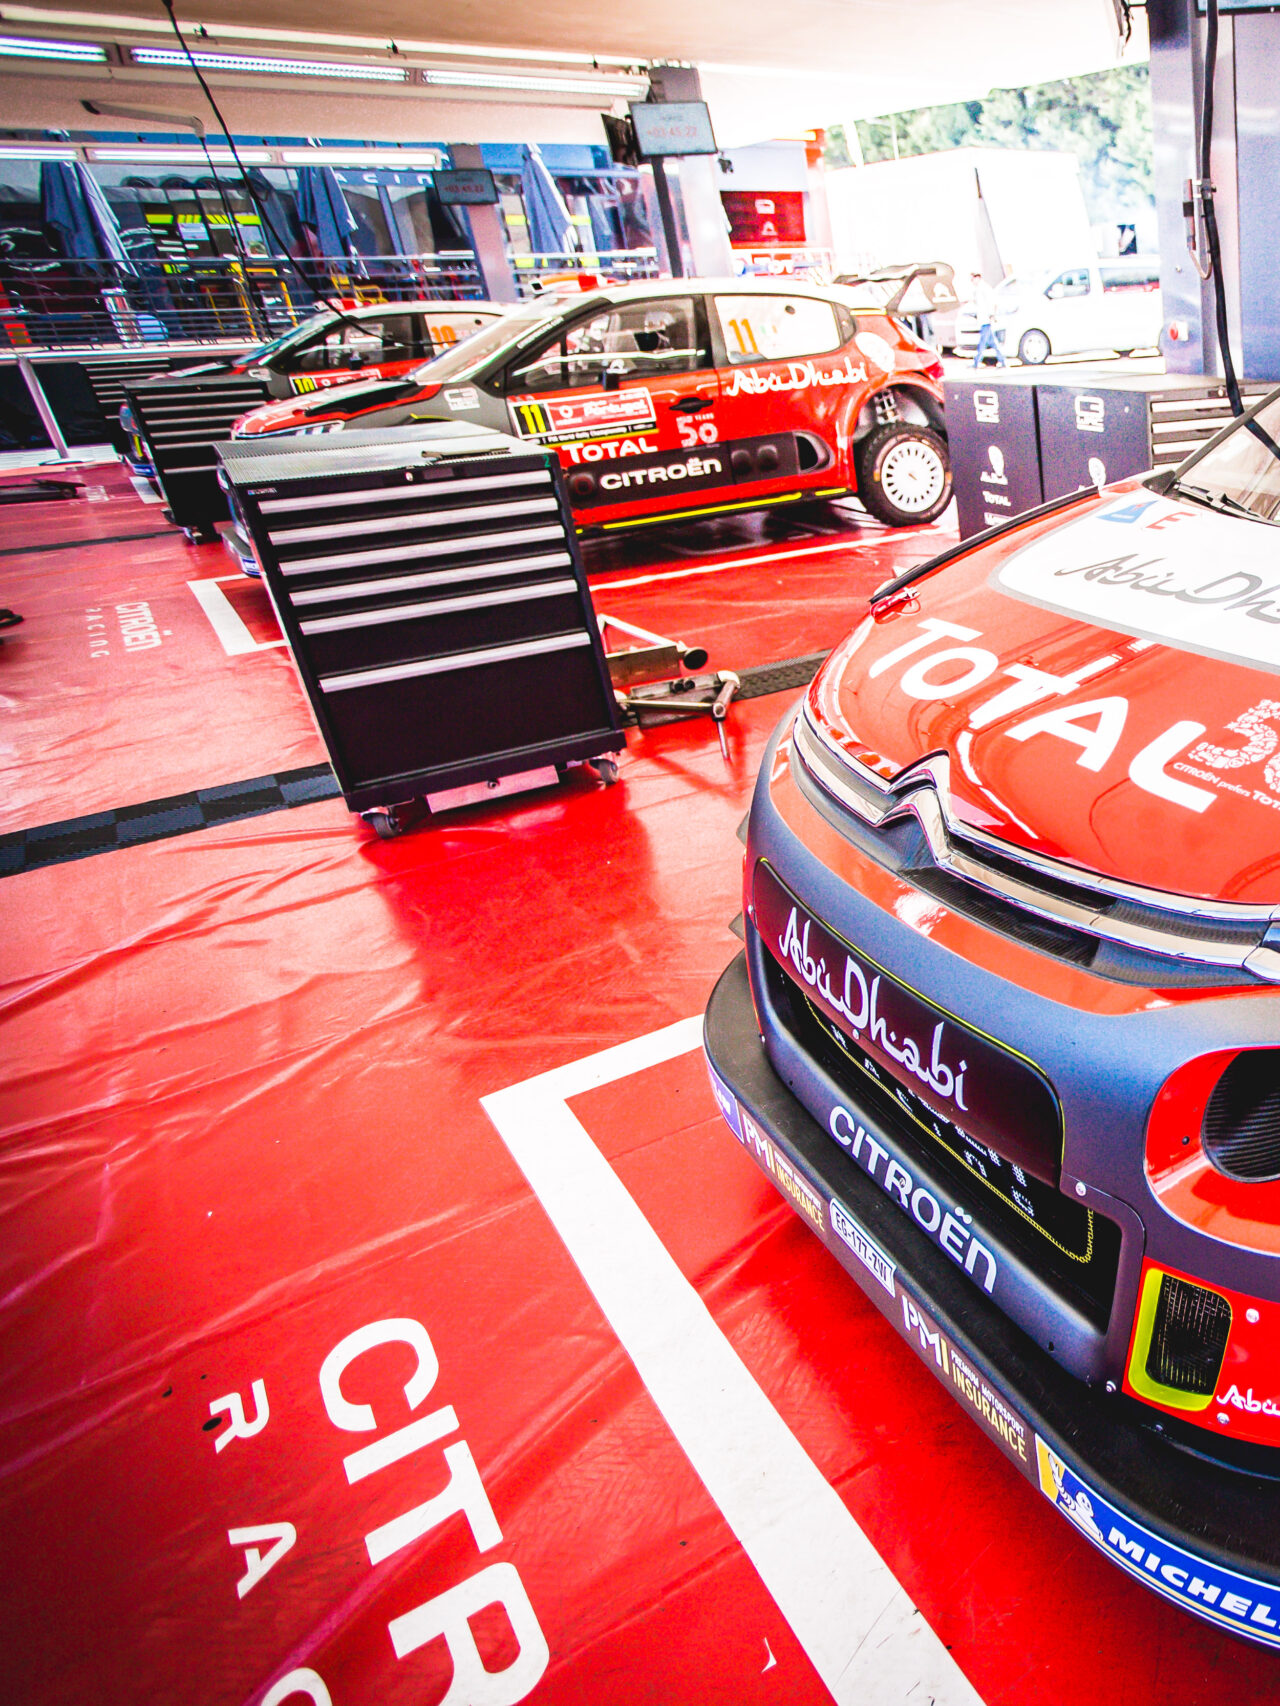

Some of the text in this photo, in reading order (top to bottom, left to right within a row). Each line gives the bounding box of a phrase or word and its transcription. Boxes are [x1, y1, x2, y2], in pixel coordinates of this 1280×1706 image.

[728, 318, 759, 355] 11
[294, 378, 316, 394] 10
[519, 403, 547, 434] 11
[561, 437, 658, 463] TOTAL
[869, 617, 1218, 813] TOTAL
[1217, 779, 1252, 798] prefers
[742, 1112, 775, 1174] PMI
[775, 1162, 825, 1232] INSURANCE
[834, 1211, 888, 1282] EG-177-ZW
[902, 1294, 950, 1376] PMI
[950, 1349, 1025, 1438] PREMIUM MOTORSPORT
[952, 1362, 1028, 1463] INSURANCE
